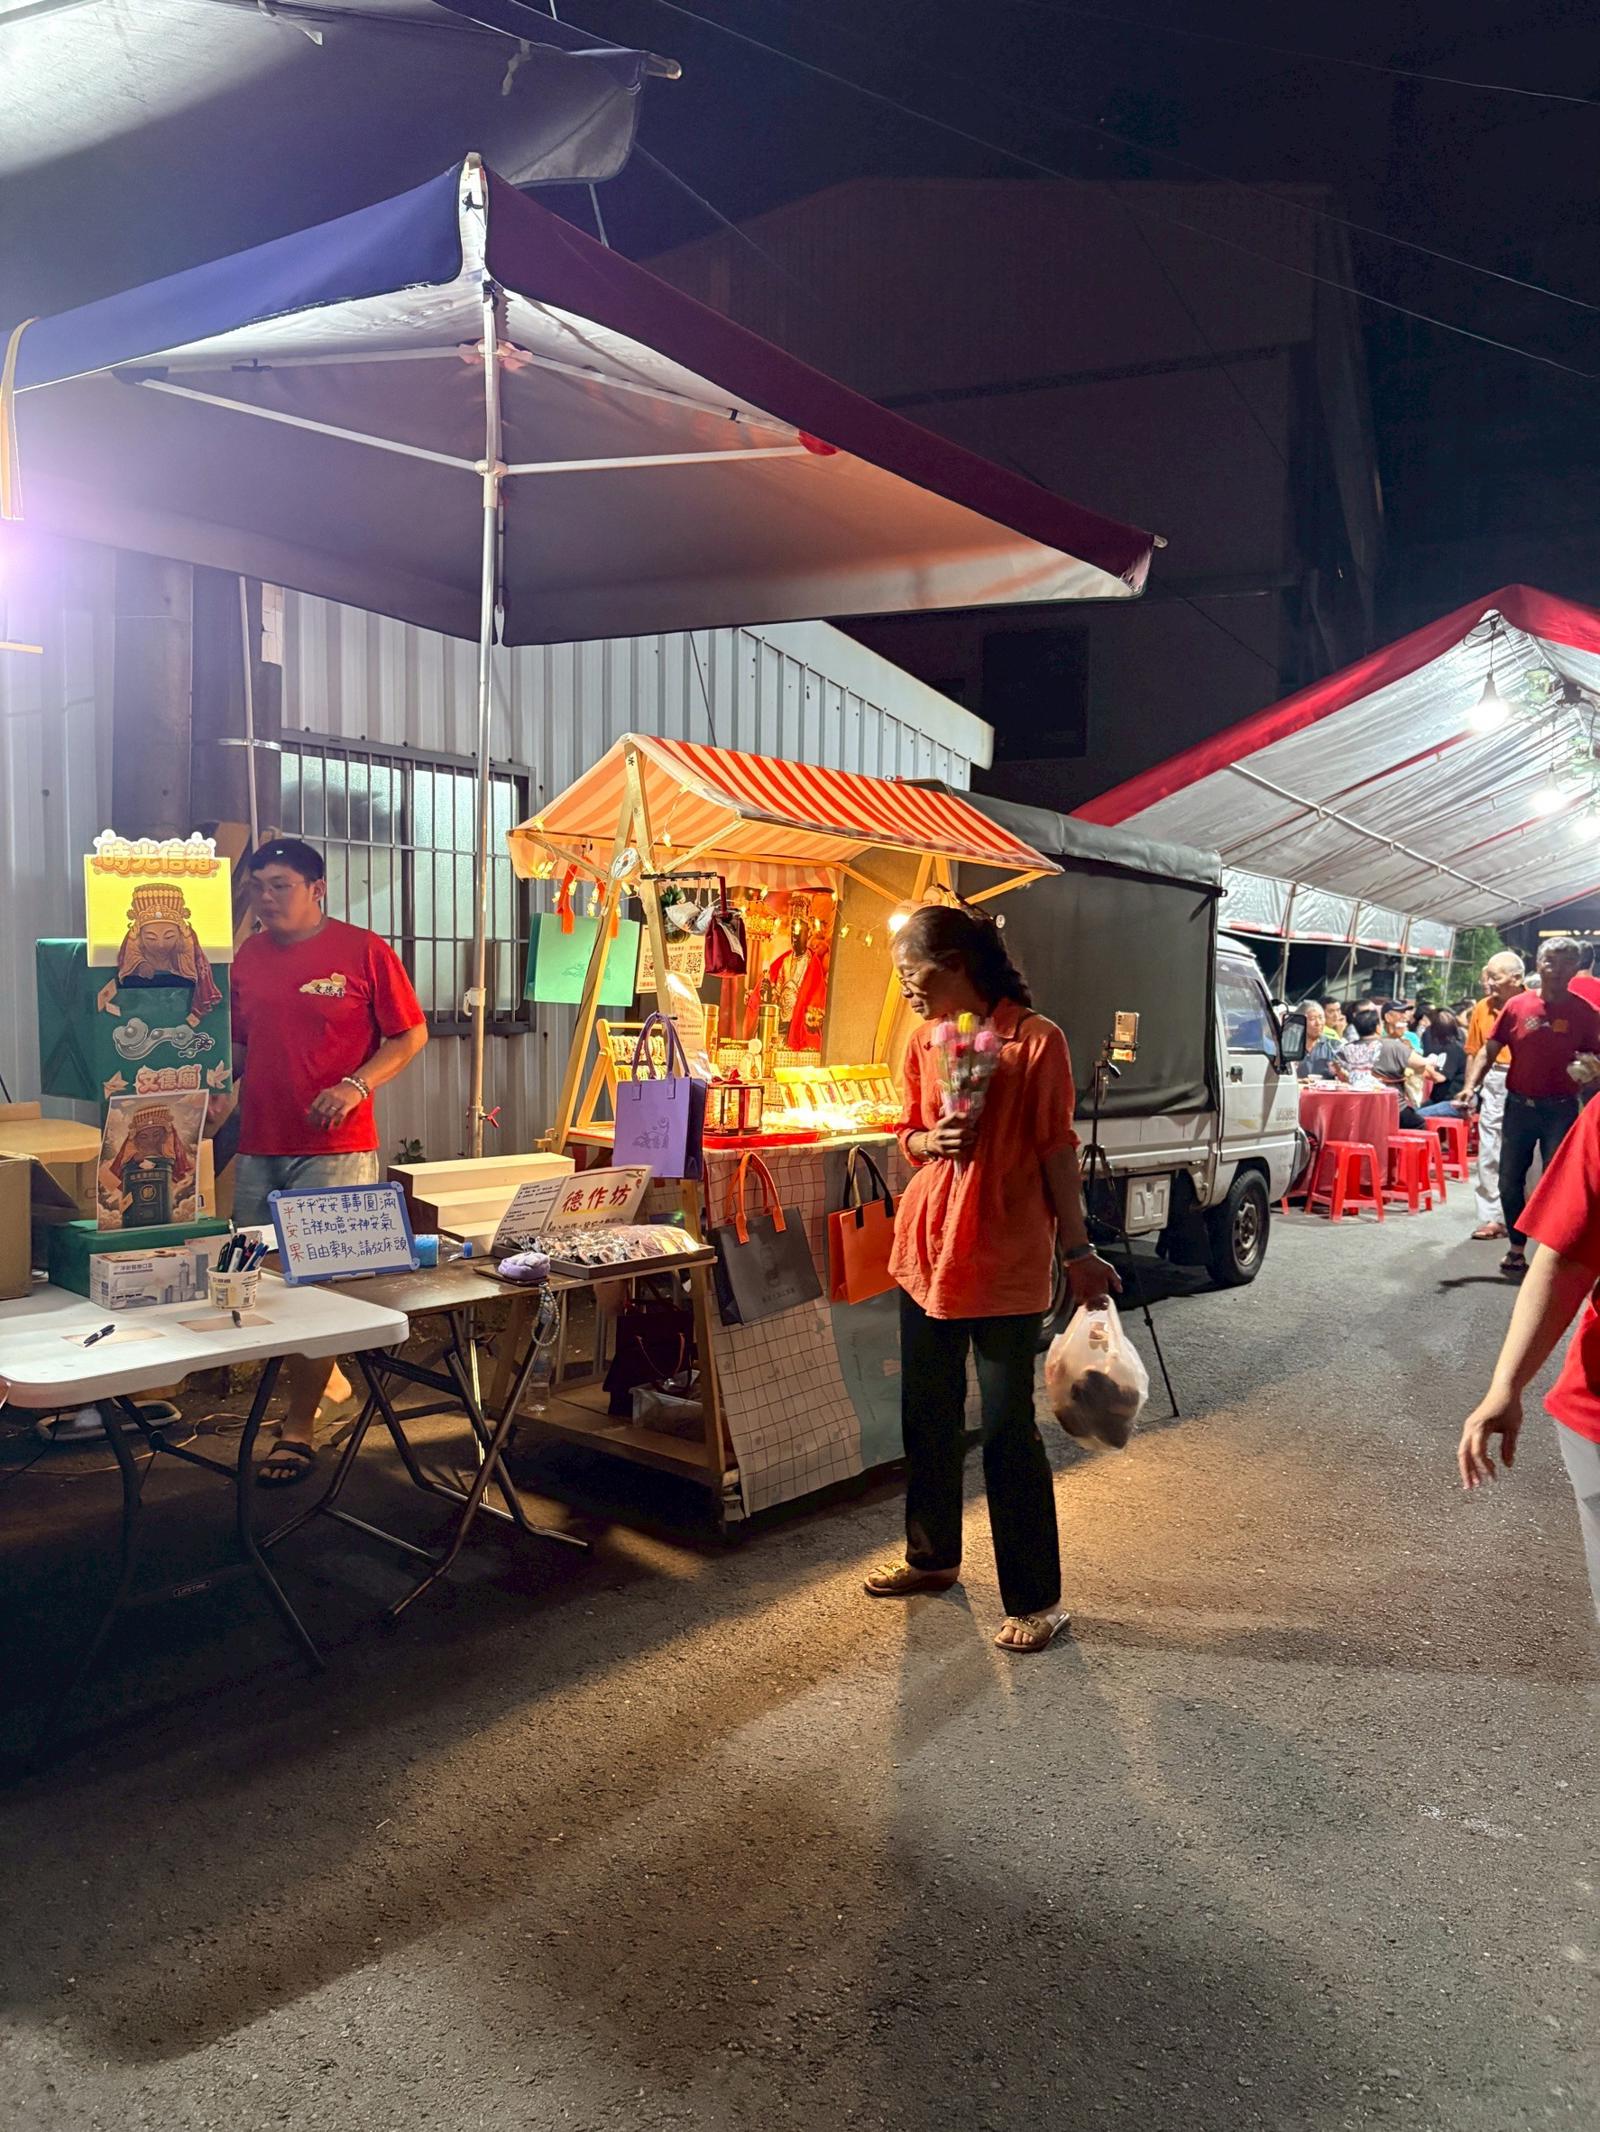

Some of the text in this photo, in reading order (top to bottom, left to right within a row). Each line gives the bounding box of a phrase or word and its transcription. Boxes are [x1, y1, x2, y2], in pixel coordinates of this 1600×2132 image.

[100, 841, 211, 872] 時光信箱
[137, 1067, 197, 1093] 文德廟
[562, 1184, 632, 1212] 德作坊
